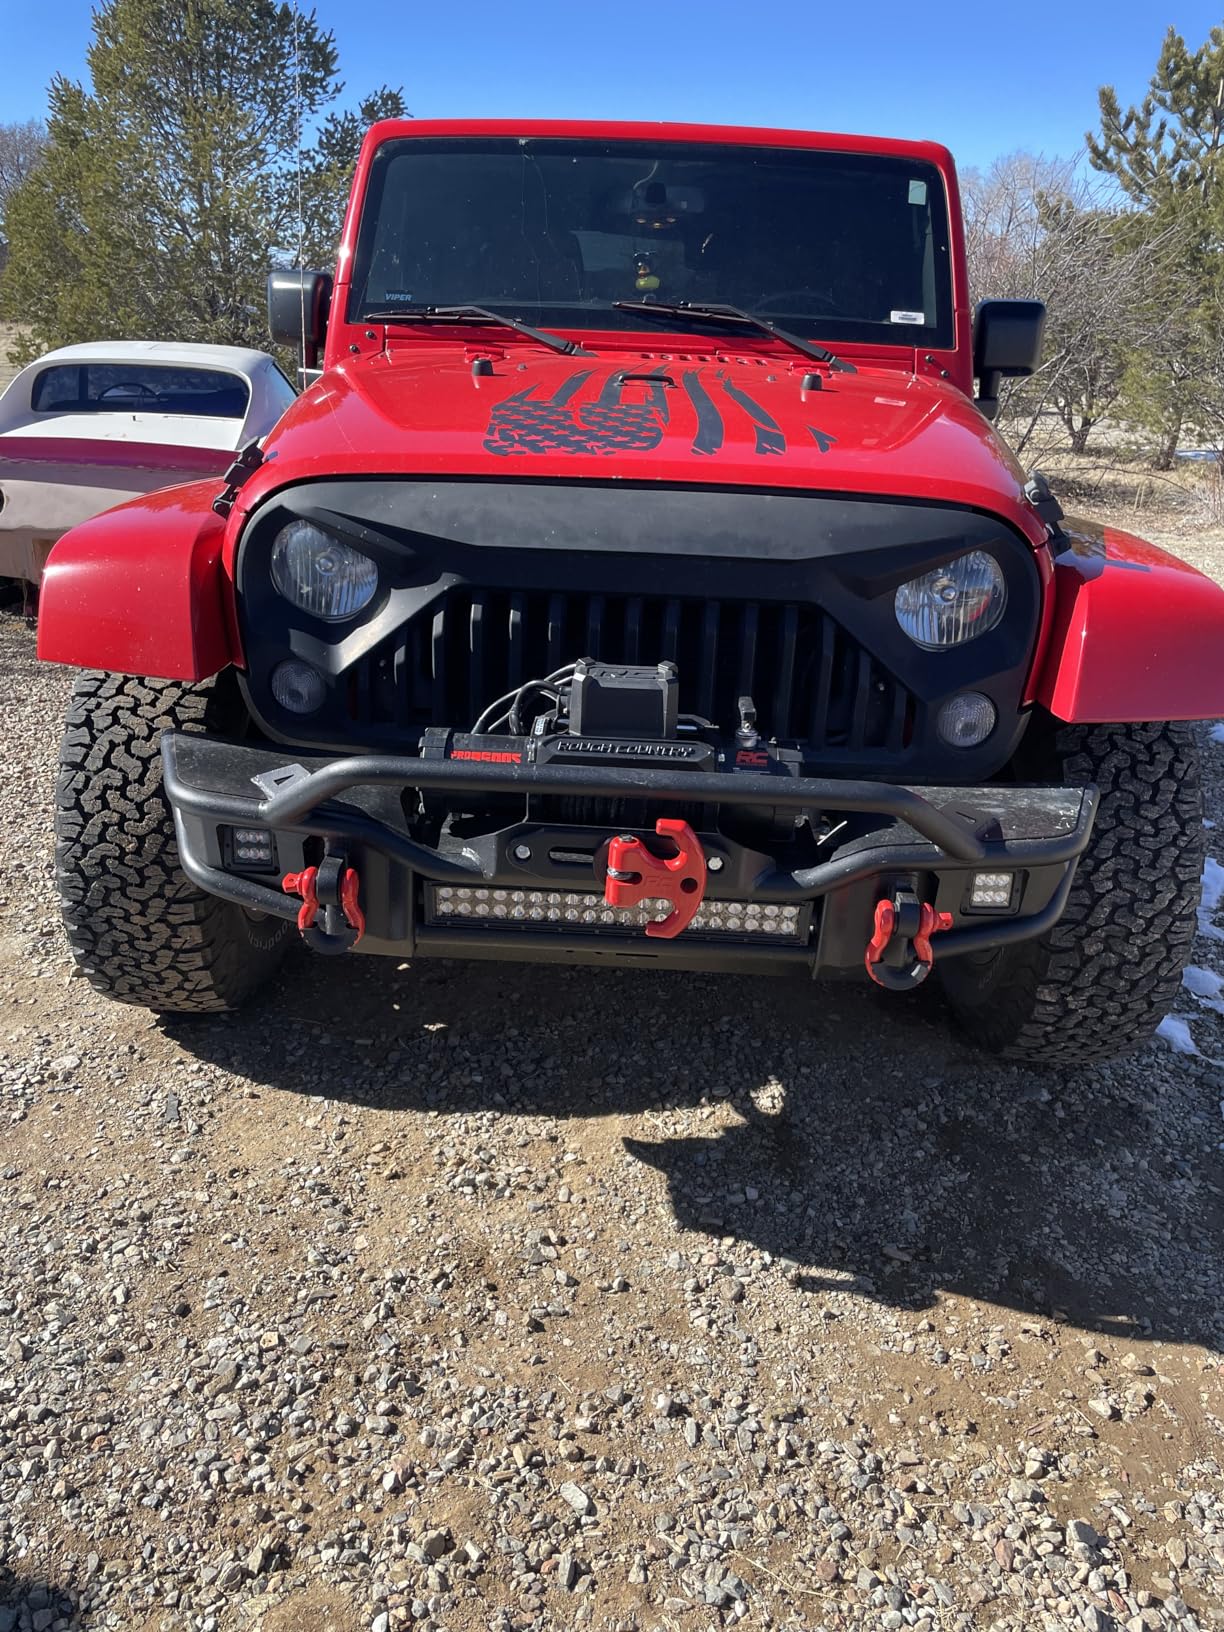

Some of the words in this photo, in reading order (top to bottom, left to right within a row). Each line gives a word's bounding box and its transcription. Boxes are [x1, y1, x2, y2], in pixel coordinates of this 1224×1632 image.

[384, 293, 413, 301] VIPER
[557, 741, 613, 753] ROUGH
[615, 744, 695, 757] COUNTRY
[735, 751, 769, 765] RC
